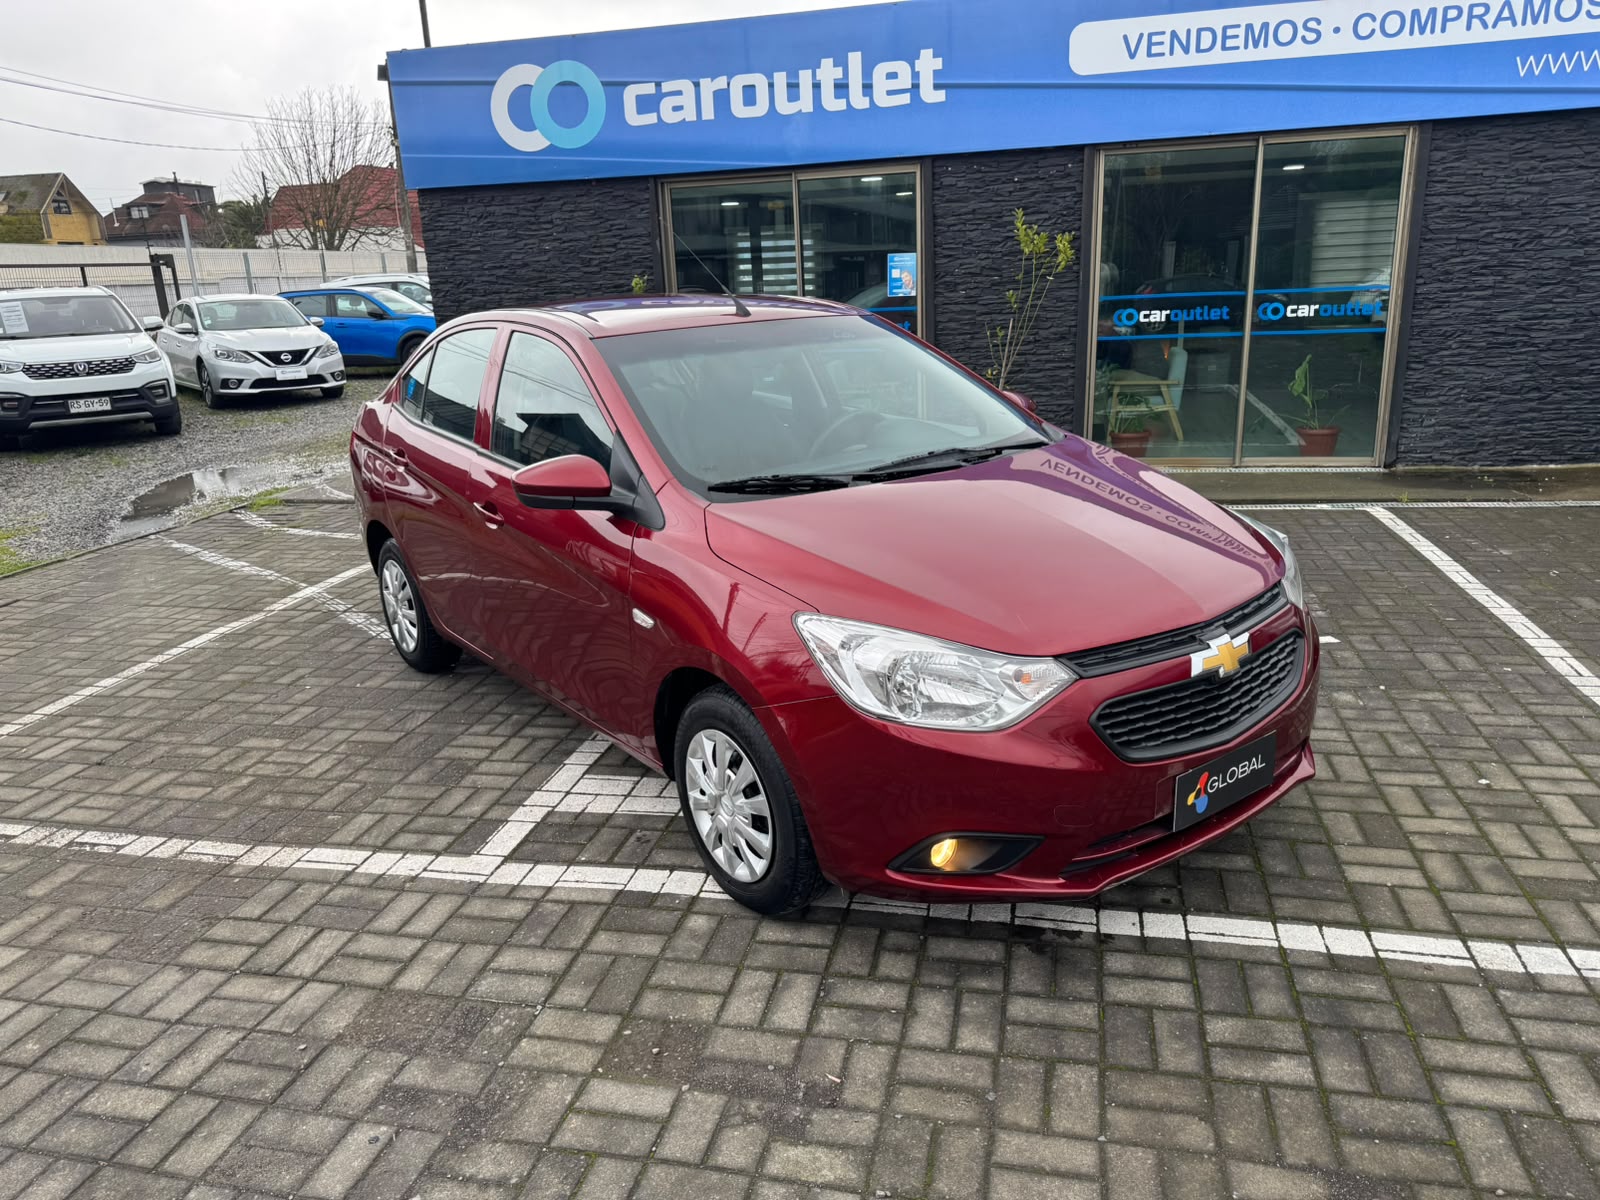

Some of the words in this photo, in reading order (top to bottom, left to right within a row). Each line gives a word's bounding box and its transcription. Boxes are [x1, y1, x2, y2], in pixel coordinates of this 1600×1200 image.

[1122, 17, 1322, 60] VENDEMOS
[622, 48, 946, 127] caroutlet
[1138, 305, 1230, 323] caroutlet
[1207, 754, 1266, 793] GLOBAL
